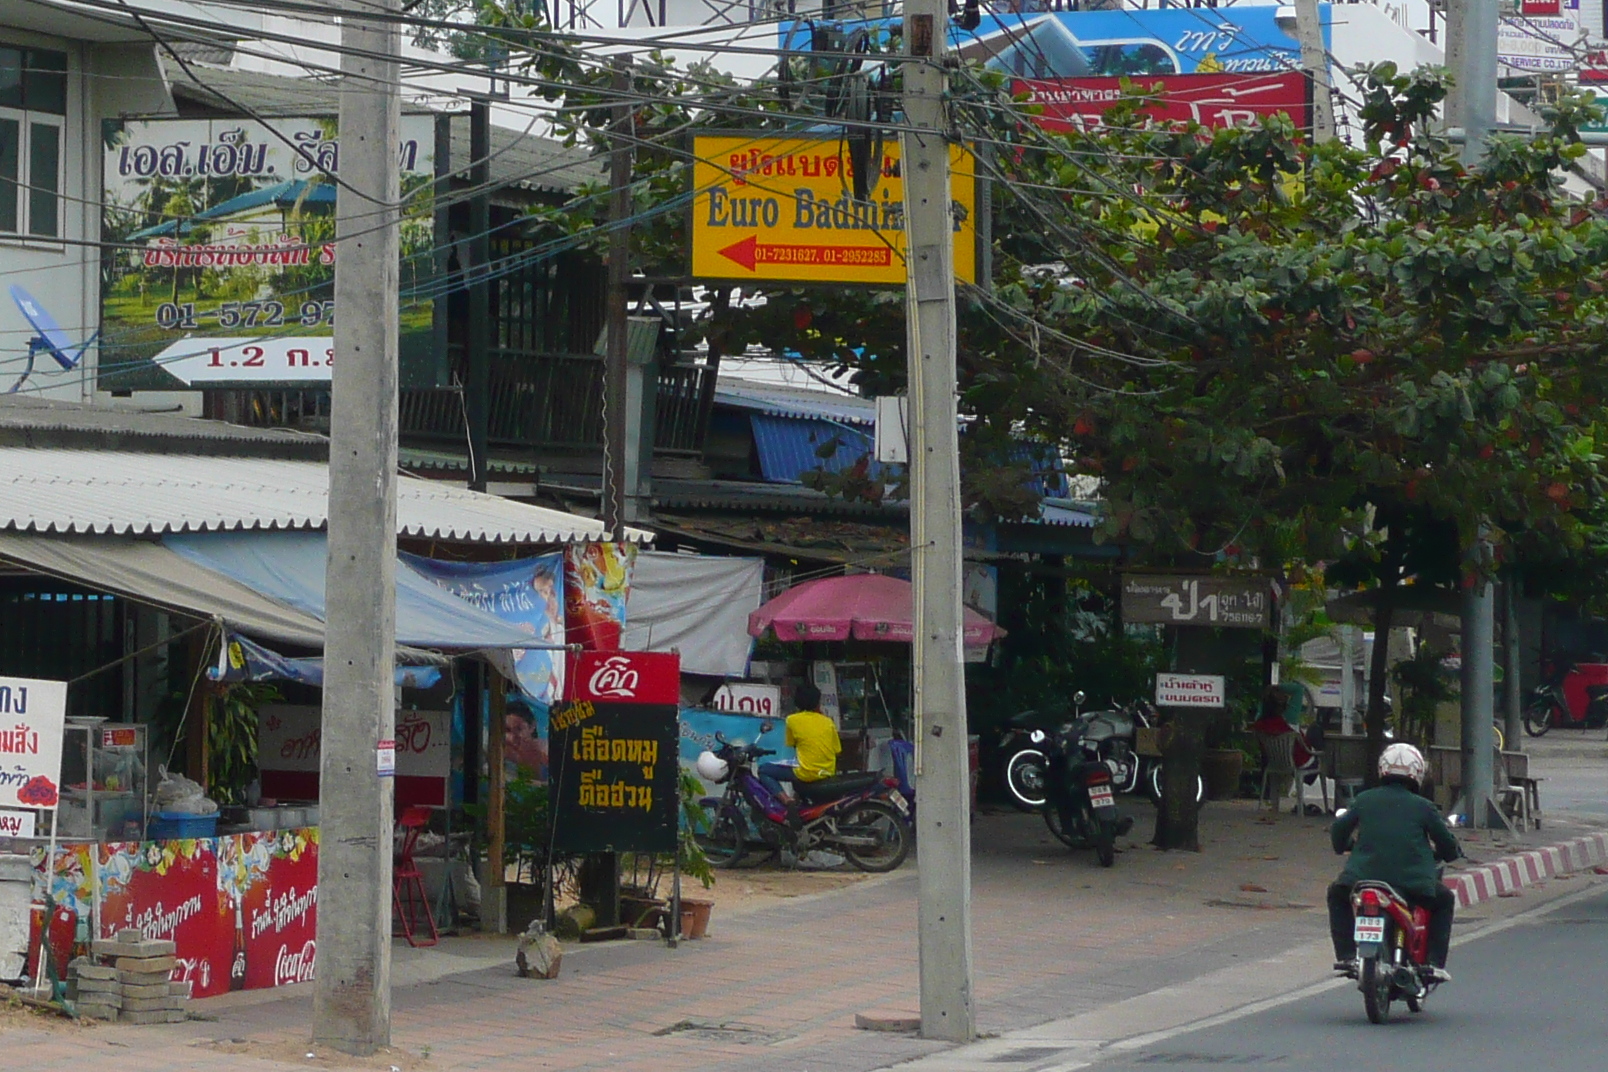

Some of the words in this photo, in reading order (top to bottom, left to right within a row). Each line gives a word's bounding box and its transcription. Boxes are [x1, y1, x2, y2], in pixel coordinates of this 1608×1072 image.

[1511, 56, 1542, 69] SERVICE
[118, 127, 276, 177] เอส.เอ็ม.
[706, 186, 780, 228] Euro
[155, 300, 286, 329] 01-572
[206, 345, 266, 368] 1.2
